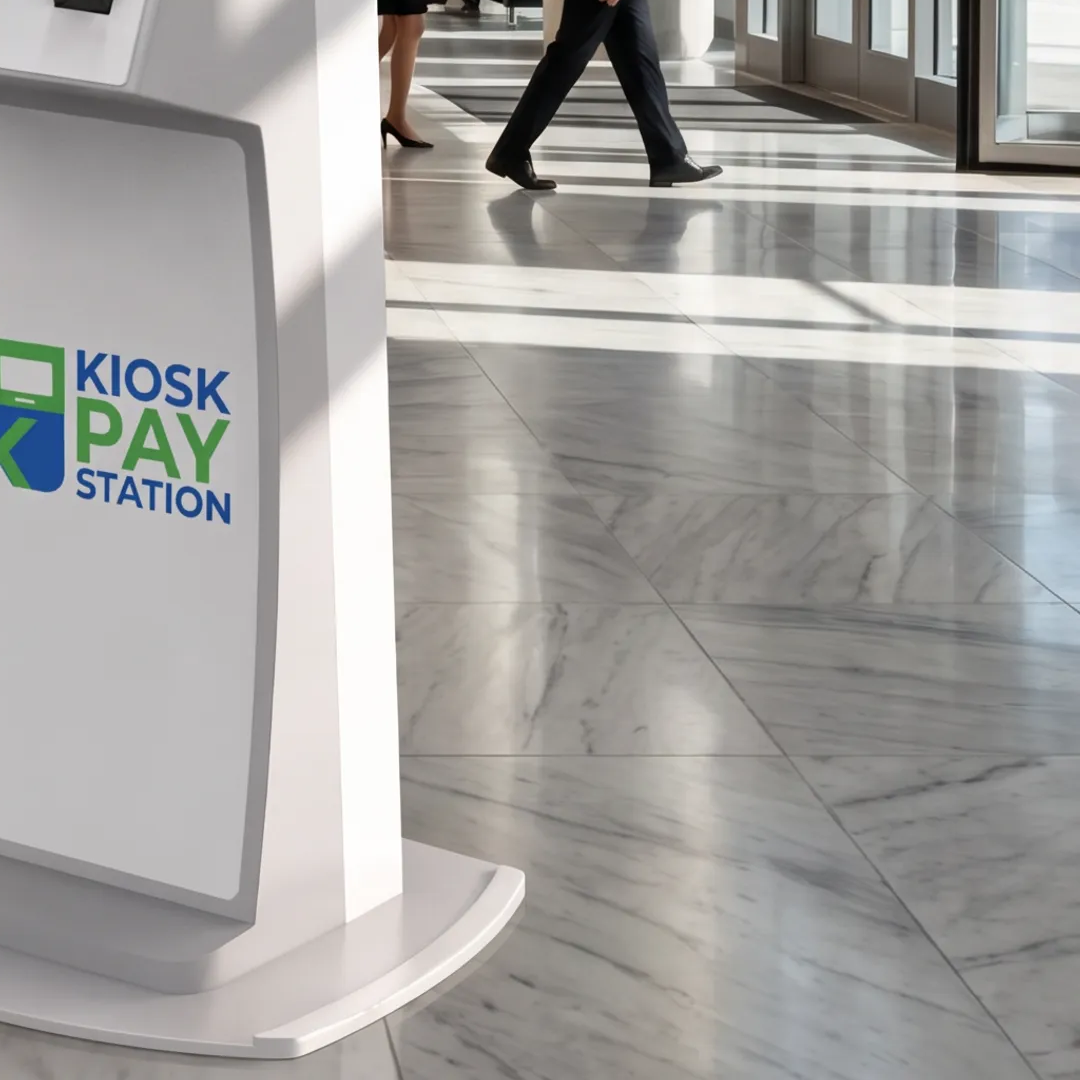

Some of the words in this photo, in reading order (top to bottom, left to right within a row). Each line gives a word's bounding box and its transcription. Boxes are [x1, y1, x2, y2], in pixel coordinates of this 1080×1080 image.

[76, 349, 231, 415] KIOSK
[76, 396, 231, 484] PAY
[76, 467, 231, 525] STATION
